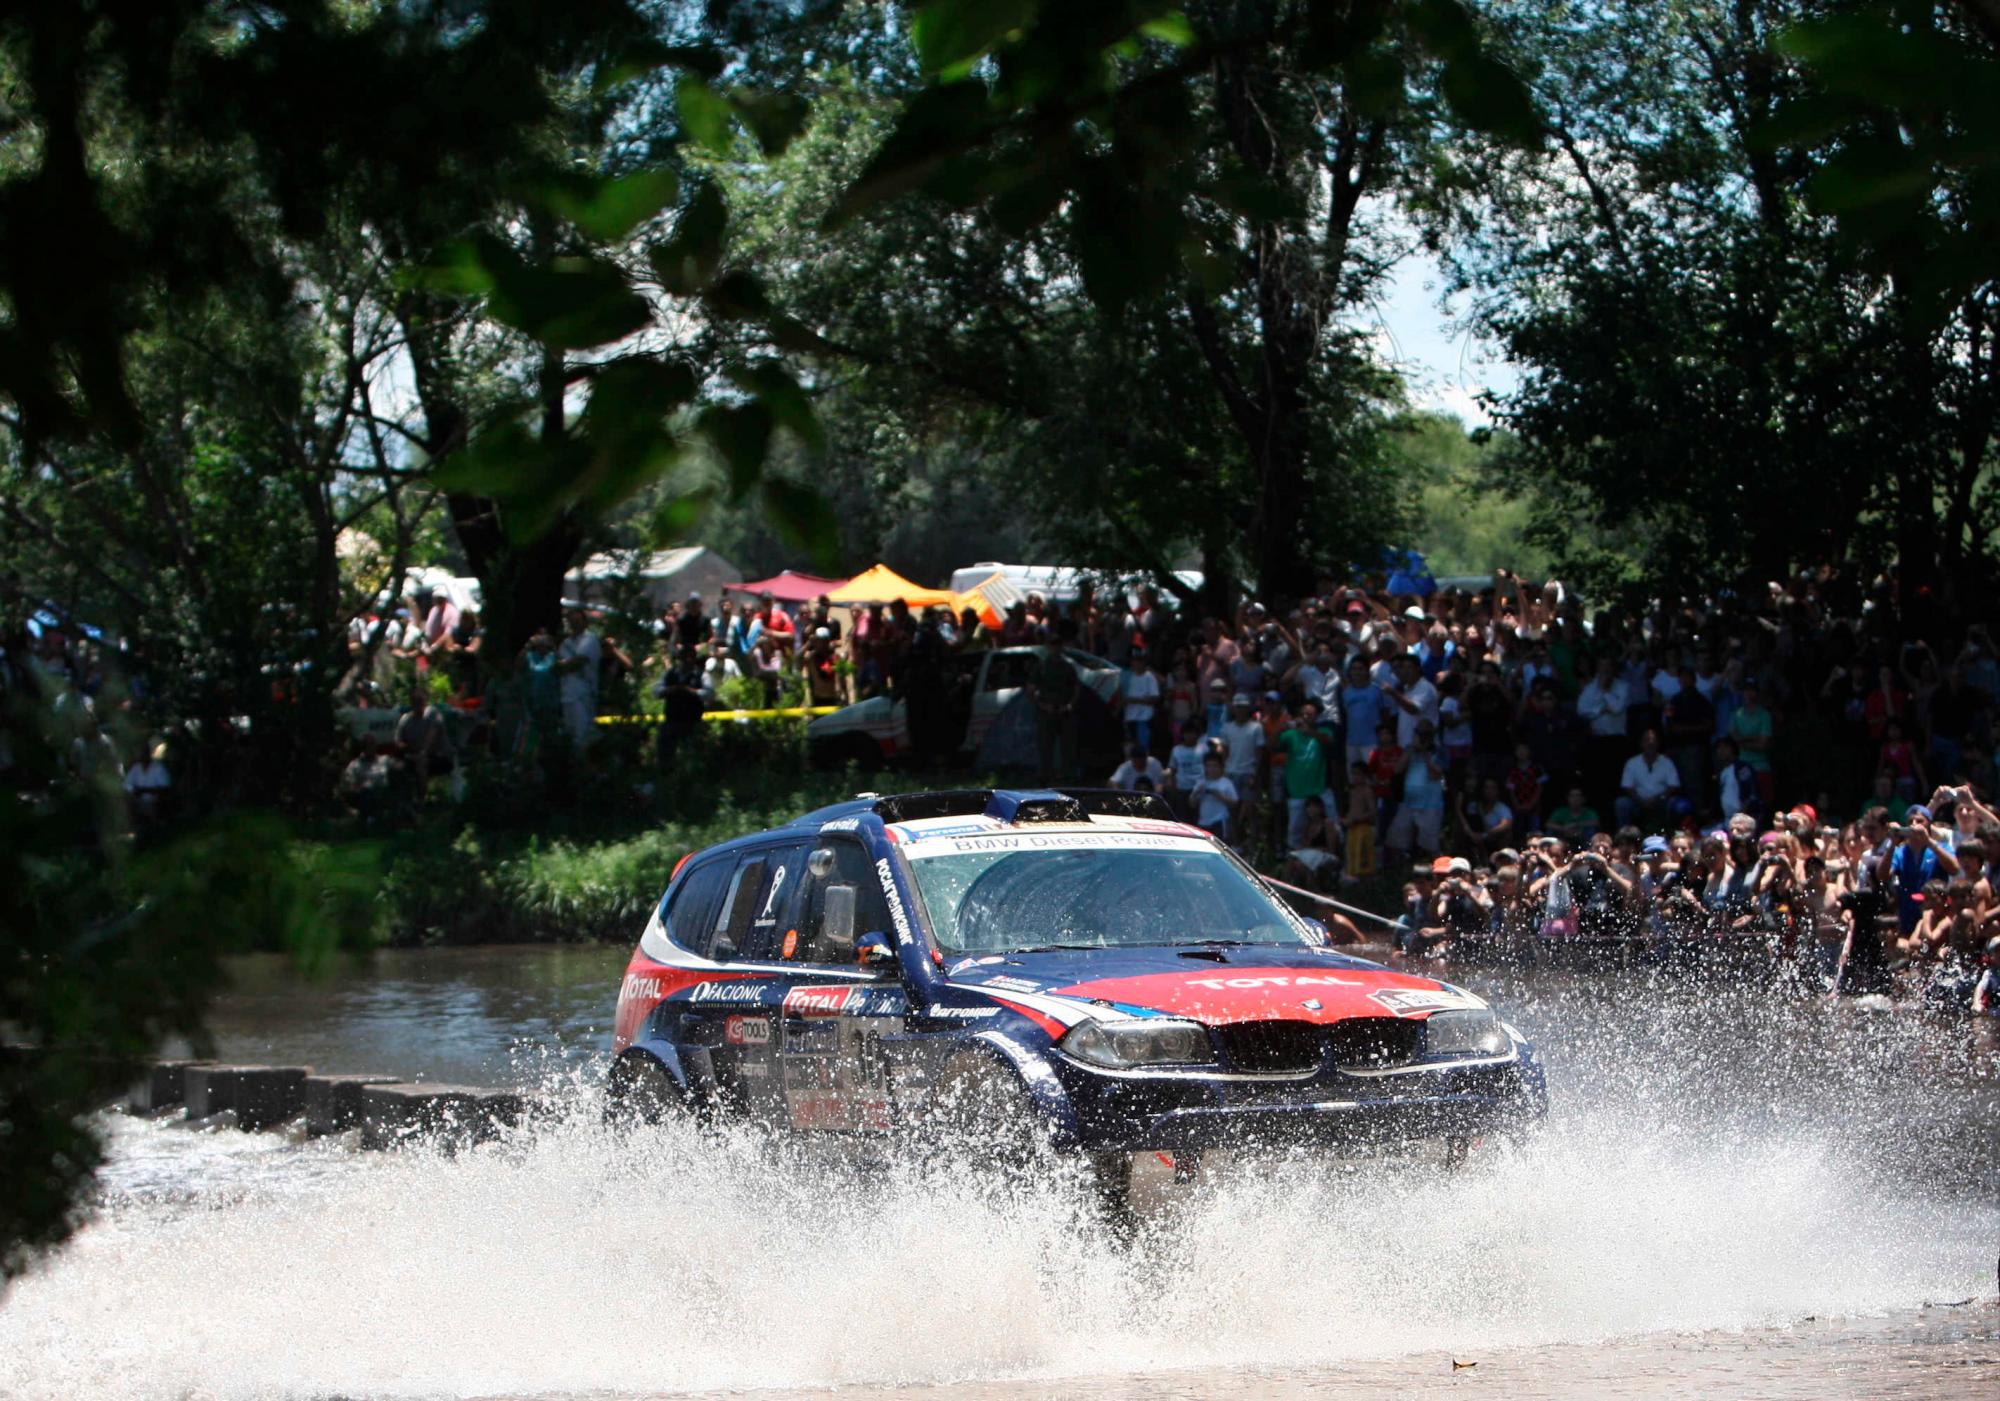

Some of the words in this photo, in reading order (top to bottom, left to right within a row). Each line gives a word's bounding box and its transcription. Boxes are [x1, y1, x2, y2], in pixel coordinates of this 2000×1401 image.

[955, 837, 1020, 851] BMW
[1030, 835, 1104, 848] Diesel
[1110, 835, 1177, 847] Power
[1185, 976, 1365, 990] TOTAL
[743, 1022, 767, 1037] TOOLS
